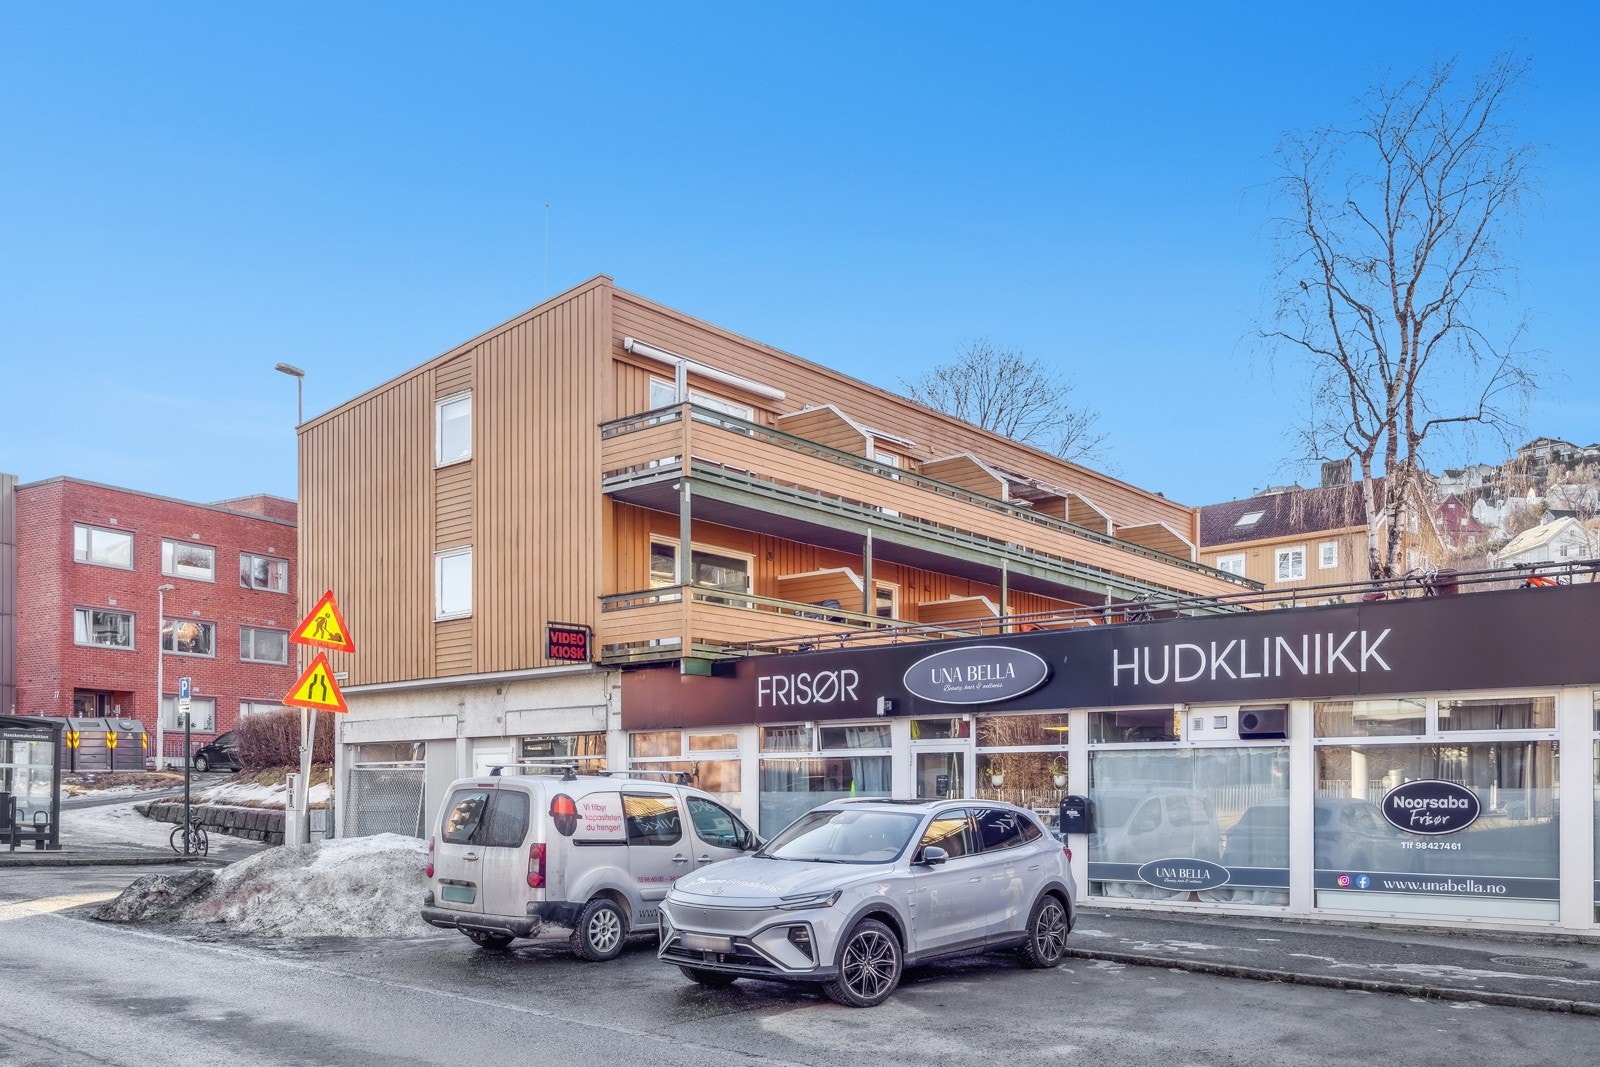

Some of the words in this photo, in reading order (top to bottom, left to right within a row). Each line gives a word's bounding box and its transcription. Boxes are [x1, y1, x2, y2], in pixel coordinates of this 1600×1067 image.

[550, 631, 585, 646] VIDEO
[551, 646, 585, 659] KIOSK
[1112, 627, 1392, 687] HUDKLINIKK
[931, 667, 963, 684] UNA
[966, 662, 1016, 682] BELLA
[181, 680, 188, 697] P
[757, 668, 859, 708] FRISØR
[582, 803, 591, 812] Vi
[1393, 796, 1470, 811] Noorsaba
[584, 813, 622, 823] kapasiteten
[1410, 808, 1451, 827] Frisør
[586, 823, 596, 831] du
[1401, 841, 1414, 850] Tlf
[1416, 841, 1462, 851] 98427461
[1156, 867, 1177, 878] UNA
[1179, 868, 1210, 879] BELLA
[1383, 877, 1507, 896] www.unabella.no
